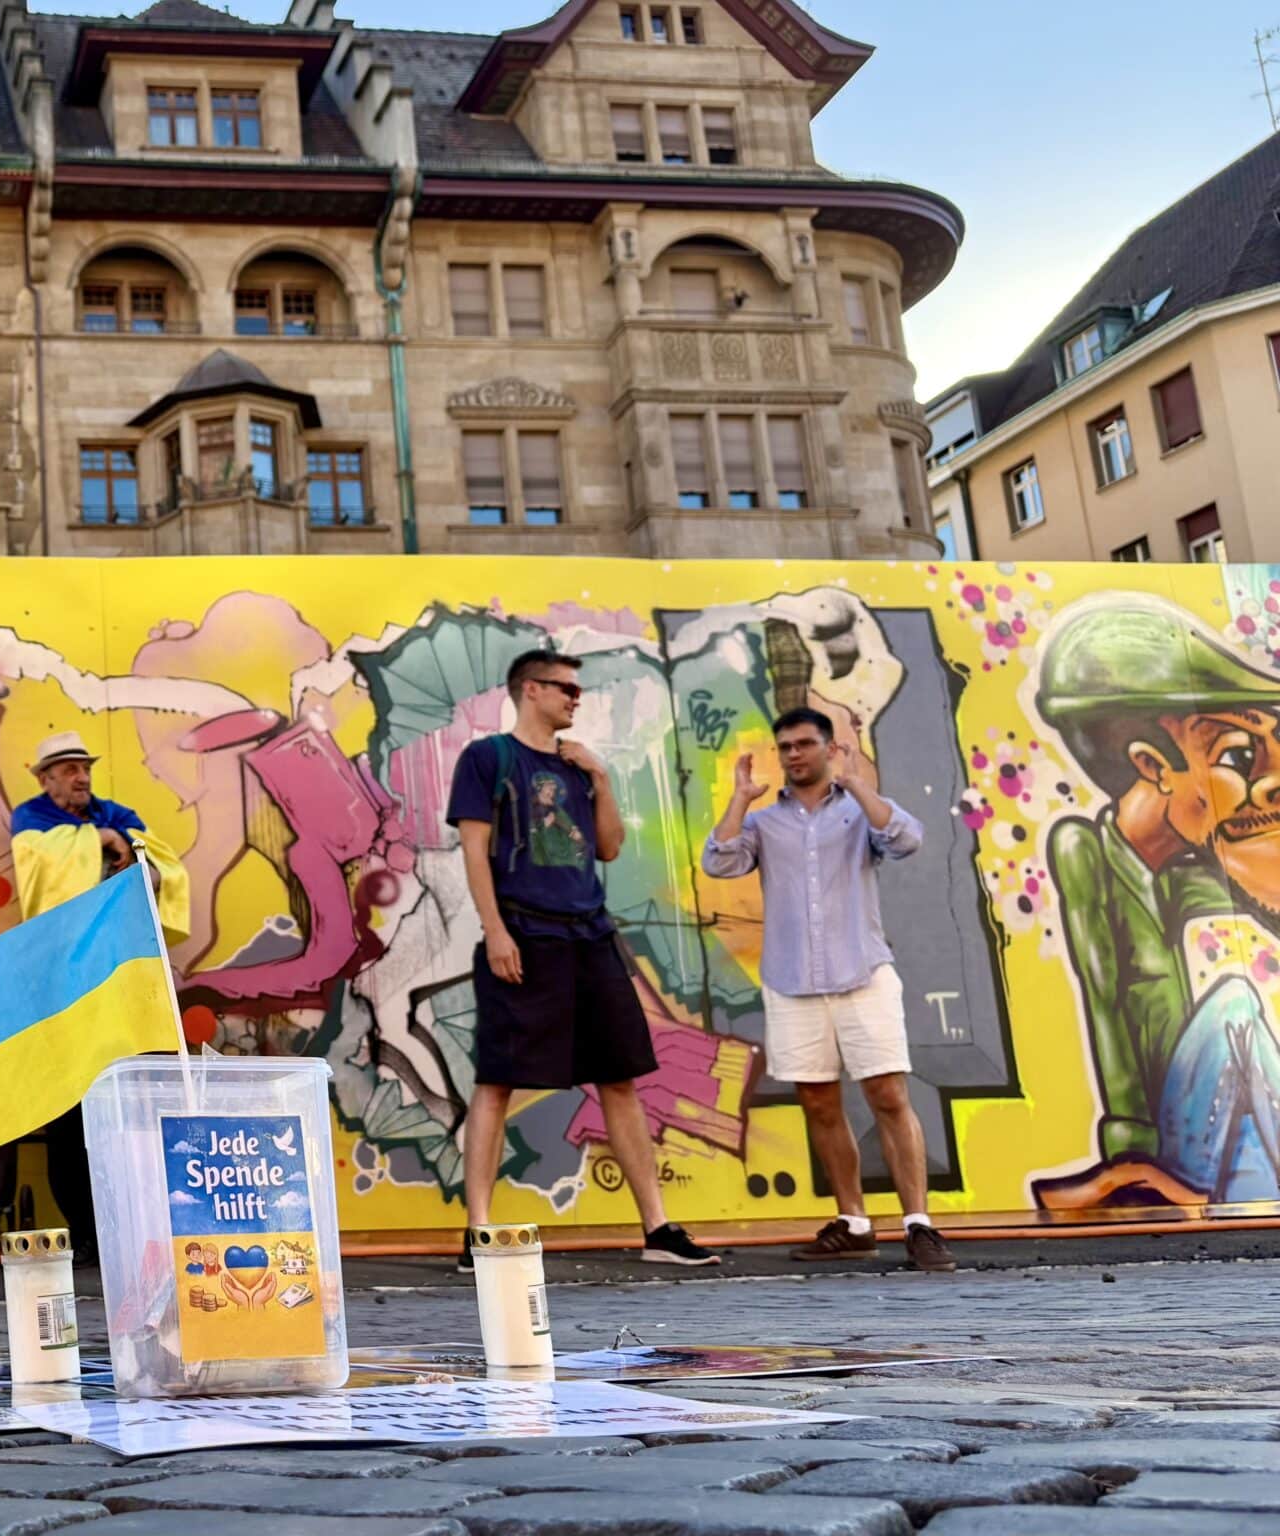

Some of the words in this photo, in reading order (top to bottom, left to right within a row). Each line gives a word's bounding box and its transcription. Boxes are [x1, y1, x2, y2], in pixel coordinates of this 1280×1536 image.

[208, 1129, 260, 1156] Jede
[186, 1157, 285, 1194] Spende
[213, 1192, 268, 1220] hilft
[455, 1386, 538, 1395] für
[297, 1399, 560, 1409] Spenden
[123, 1415, 214, 1426] zur
[229, 1406, 685, 1421] Unterstützung
[271, 1424, 373, 1432] der
[389, 1417, 645, 1431] Ukraine
